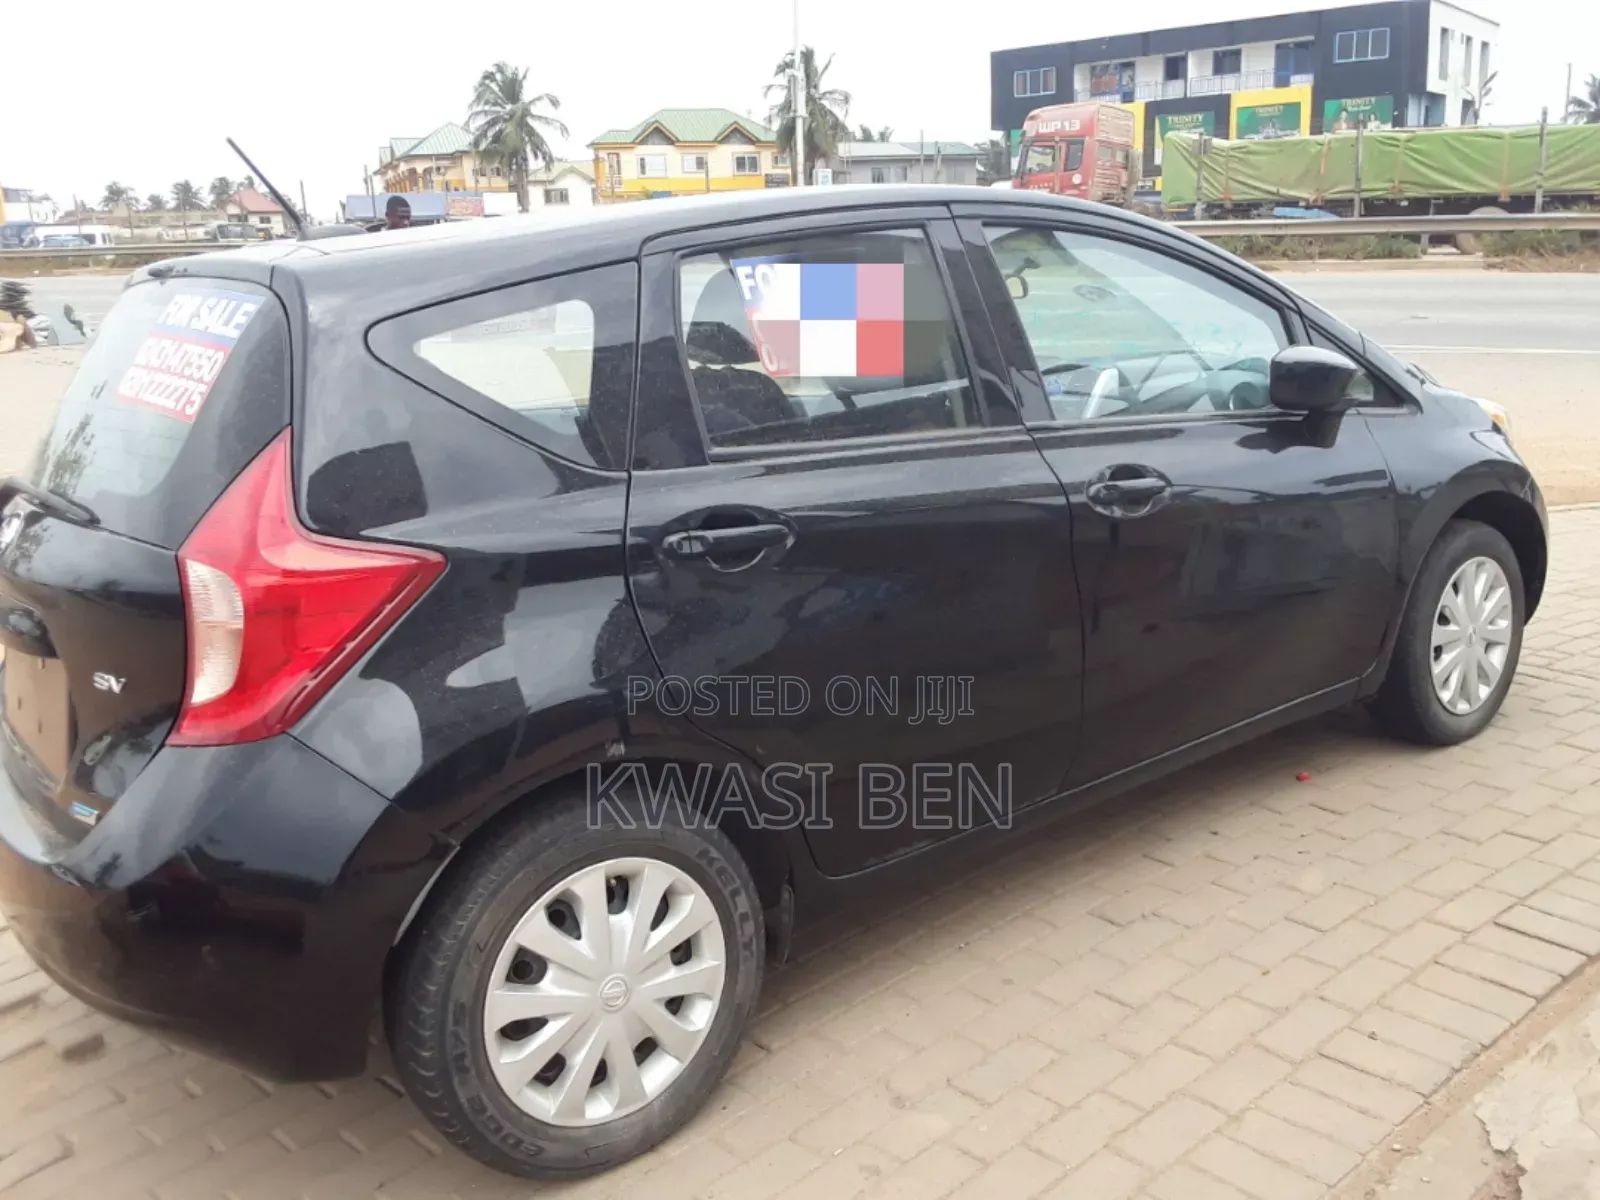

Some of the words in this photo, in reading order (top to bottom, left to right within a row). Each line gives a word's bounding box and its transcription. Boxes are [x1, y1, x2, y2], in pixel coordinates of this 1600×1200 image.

[1341, 98, 1375, 108] TRINITY
[1256, 105, 1285, 114] TRINITY
[1063, 119, 1081, 131] 13
[1167, 113, 1203, 125] TRINITY
[157, 294, 203, 327] FOR
[190, 297, 257, 338] SALE
[92, 671, 127, 695] SV
